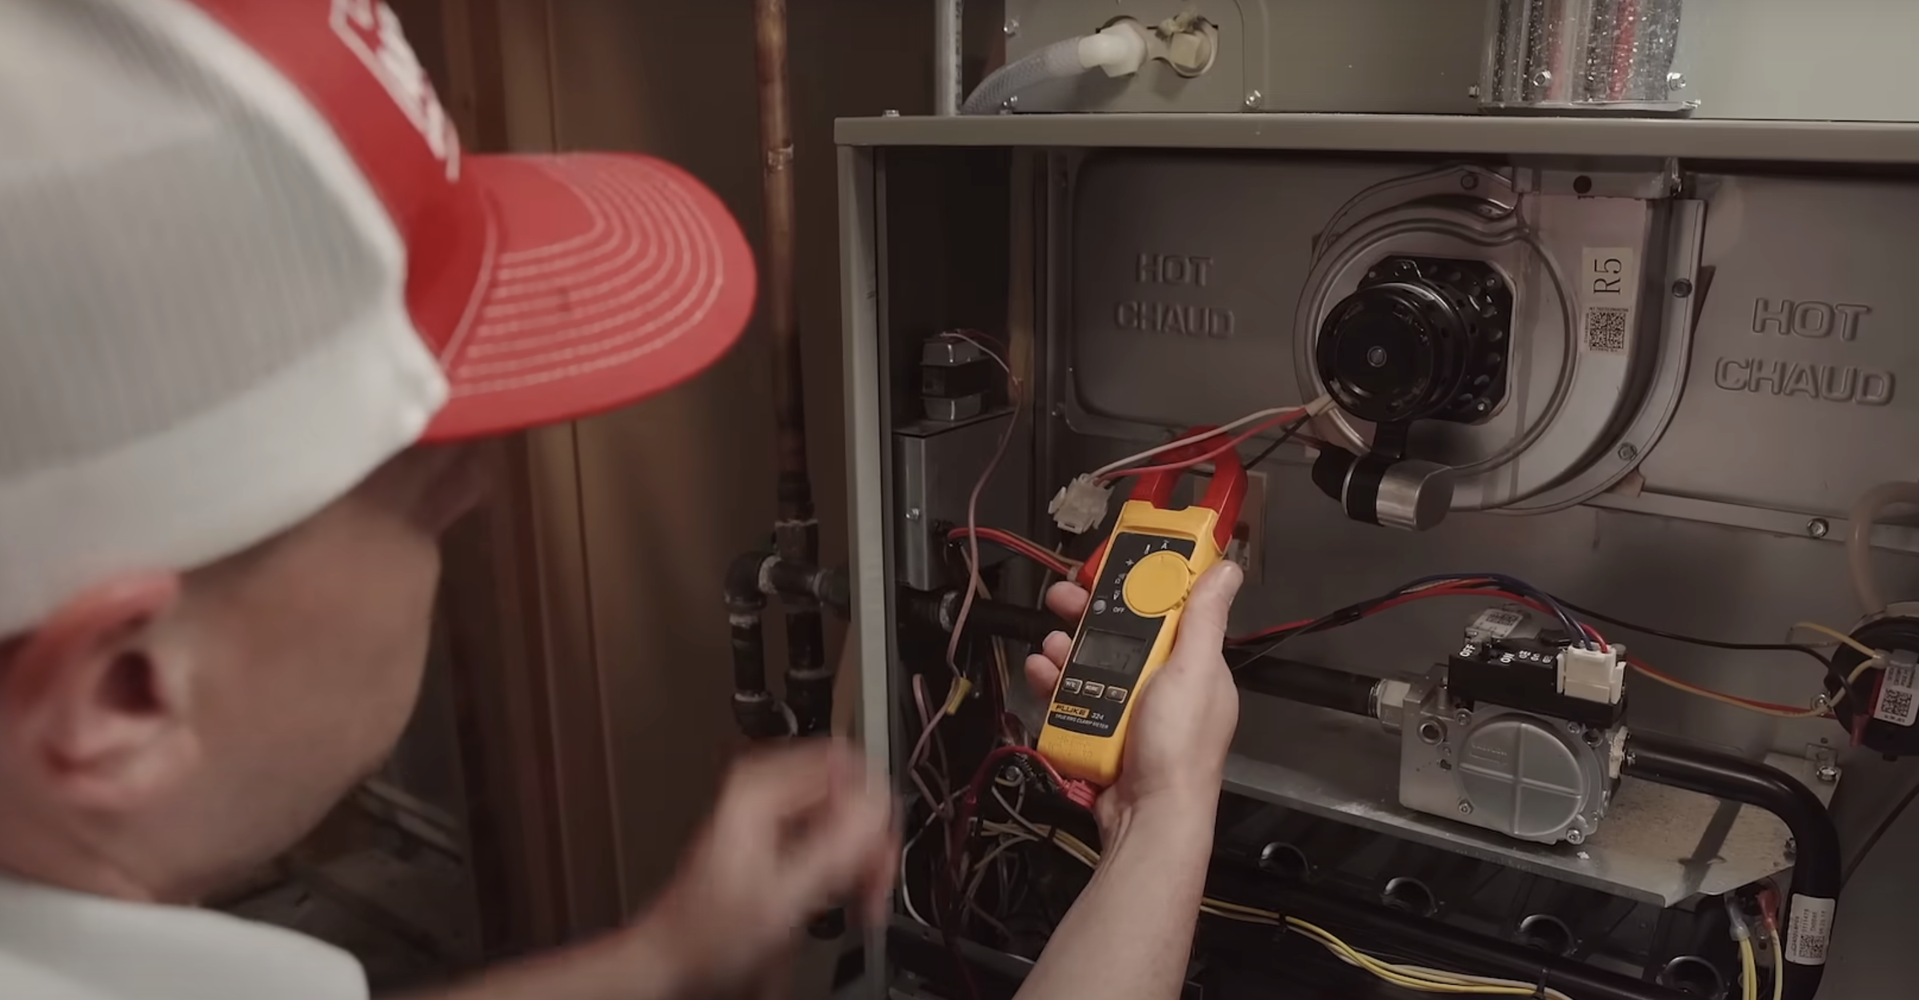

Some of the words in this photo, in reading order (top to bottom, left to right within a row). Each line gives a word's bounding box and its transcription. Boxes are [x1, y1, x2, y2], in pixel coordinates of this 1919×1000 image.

[1136, 253, 1213, 287] HOT
[1593, 258, 1622, 295] R5
[1114, 301, 1235, 339] CHAUD
[1752, 298, 1872, 342] HOT
[1714, 357, 1896, 406] CHAUD
[1459, 643, 1476, 657] OFF
[1500, 652, 1515, 663] ON
[1056, 704, 1088, 716] FLUKE
[1091, 712, 1105, 720] 324
